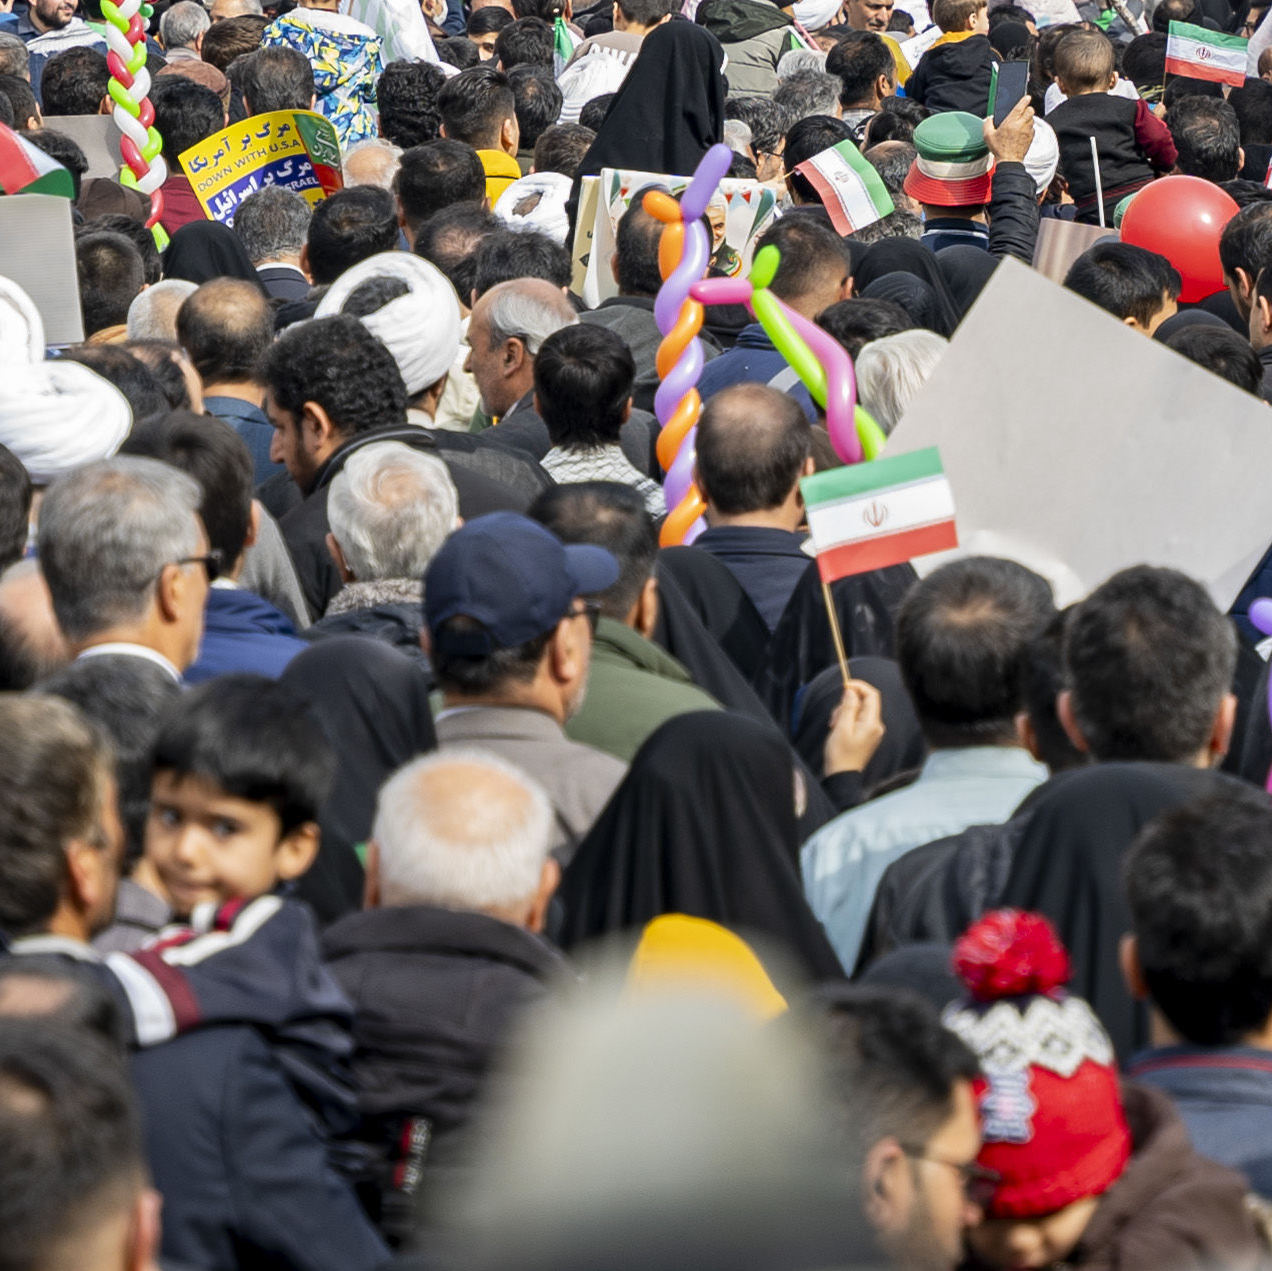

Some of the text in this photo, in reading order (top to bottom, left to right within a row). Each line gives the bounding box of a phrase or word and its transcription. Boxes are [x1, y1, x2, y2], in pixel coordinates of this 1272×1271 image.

[187, 121, 291, 174] مرگ بر آمریکا
[197, 166, 234, 193] DOWN
[234, 149, 268, 168] WITH
[276, 158, 313, 178] مرگ
[286, 177, 320, 194] SRAEL
